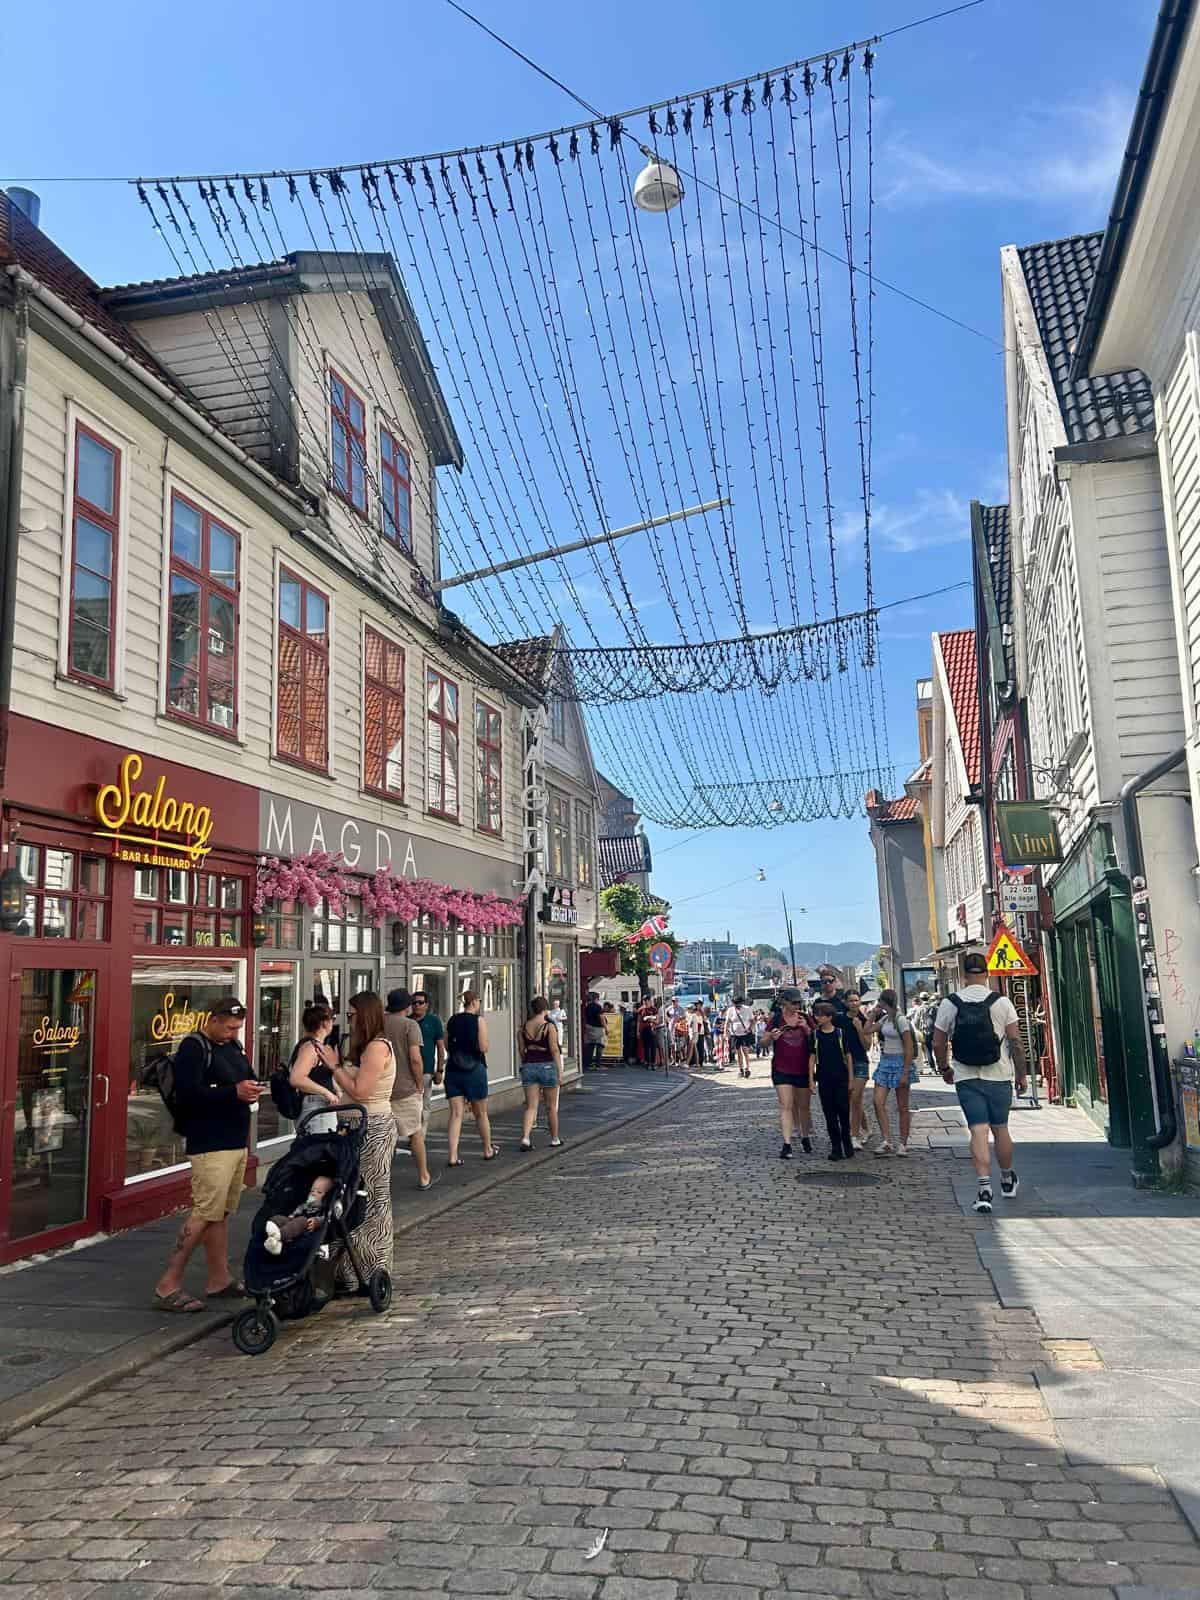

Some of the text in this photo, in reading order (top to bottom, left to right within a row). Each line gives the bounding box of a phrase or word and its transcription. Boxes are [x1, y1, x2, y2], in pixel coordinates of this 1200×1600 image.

[96, 753, 214, 860] Salong
[265, 799, 418, 879] MAGDA
[1011, 832, 1056, 857] Vinyl
[121, 849, 191, 869] BAR & BILLIARD
[33, 1015, 80, 1048] Salong
